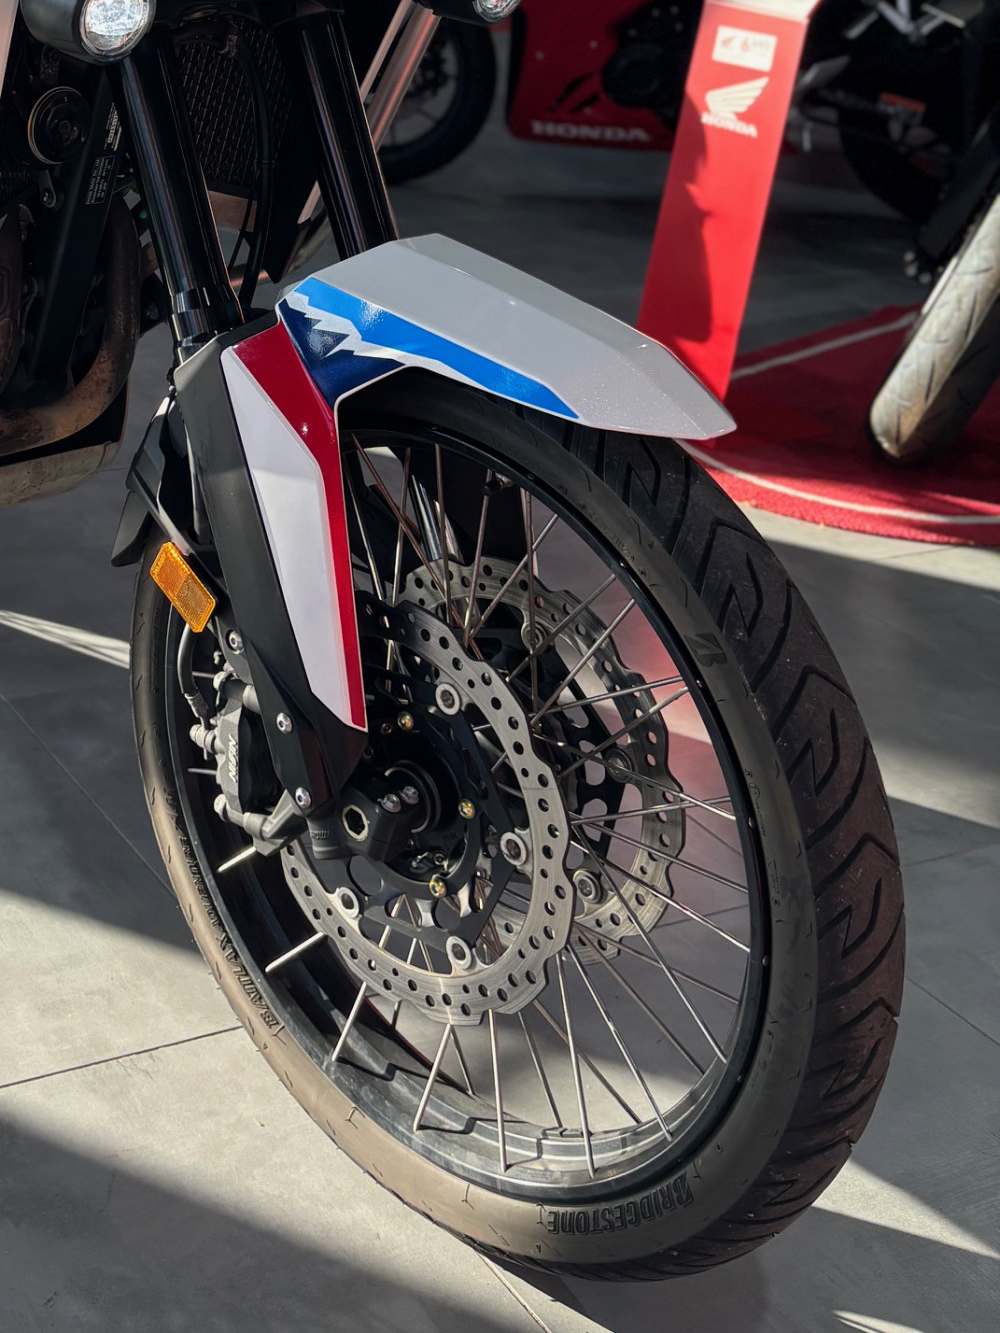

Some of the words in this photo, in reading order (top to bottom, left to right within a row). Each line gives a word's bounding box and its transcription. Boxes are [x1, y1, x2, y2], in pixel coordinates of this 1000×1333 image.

[531, 120, 651, 143] HONDA
[217, 932, 278, 1030] BATTLAX
[547, 1171, 694, 1235] BRIDGESTONE
